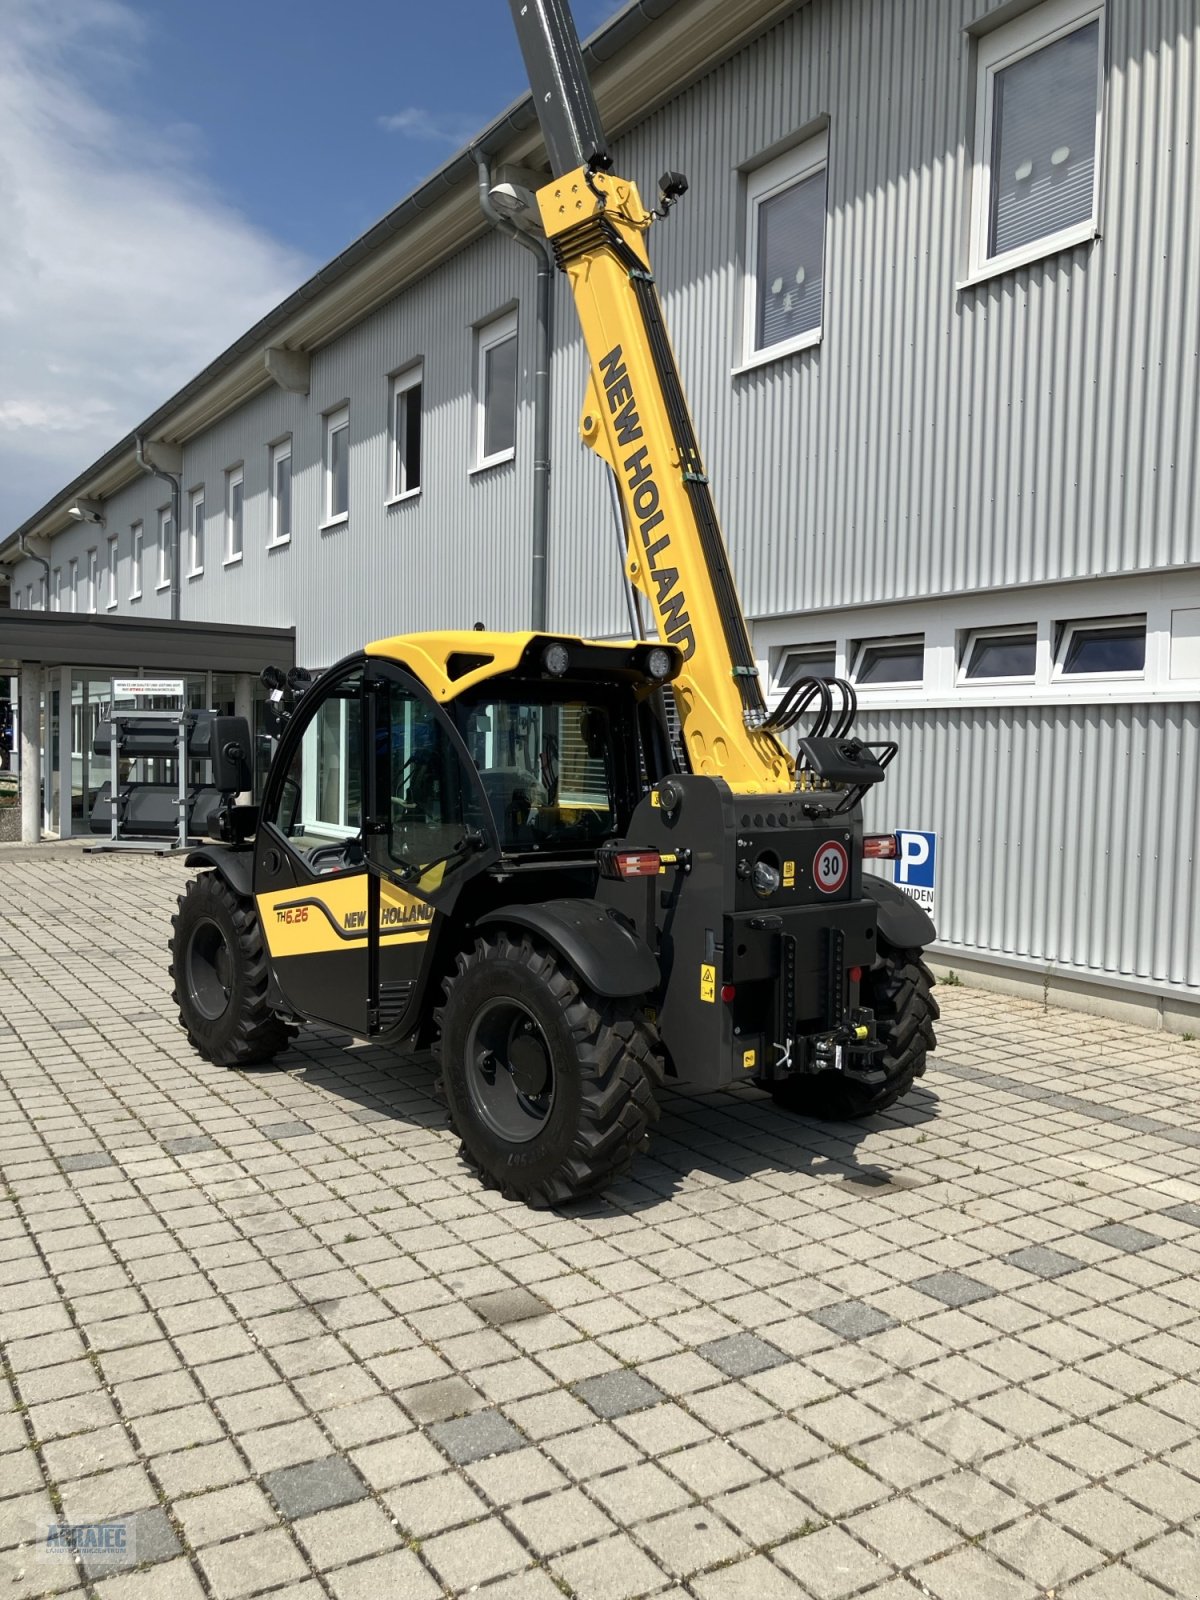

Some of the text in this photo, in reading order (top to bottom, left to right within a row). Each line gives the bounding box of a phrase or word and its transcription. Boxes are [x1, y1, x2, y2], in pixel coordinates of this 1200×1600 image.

[598, 344, 696, 663] NEW HOLLAND
[823, 856, 839, 876] 30
[900, 833, 929, 882] P
[900, 887, 934, 903] NDEN
[276, 907, 309, 924] TH6.26
[344, 904, 434, 929] NEW HOLLAND
